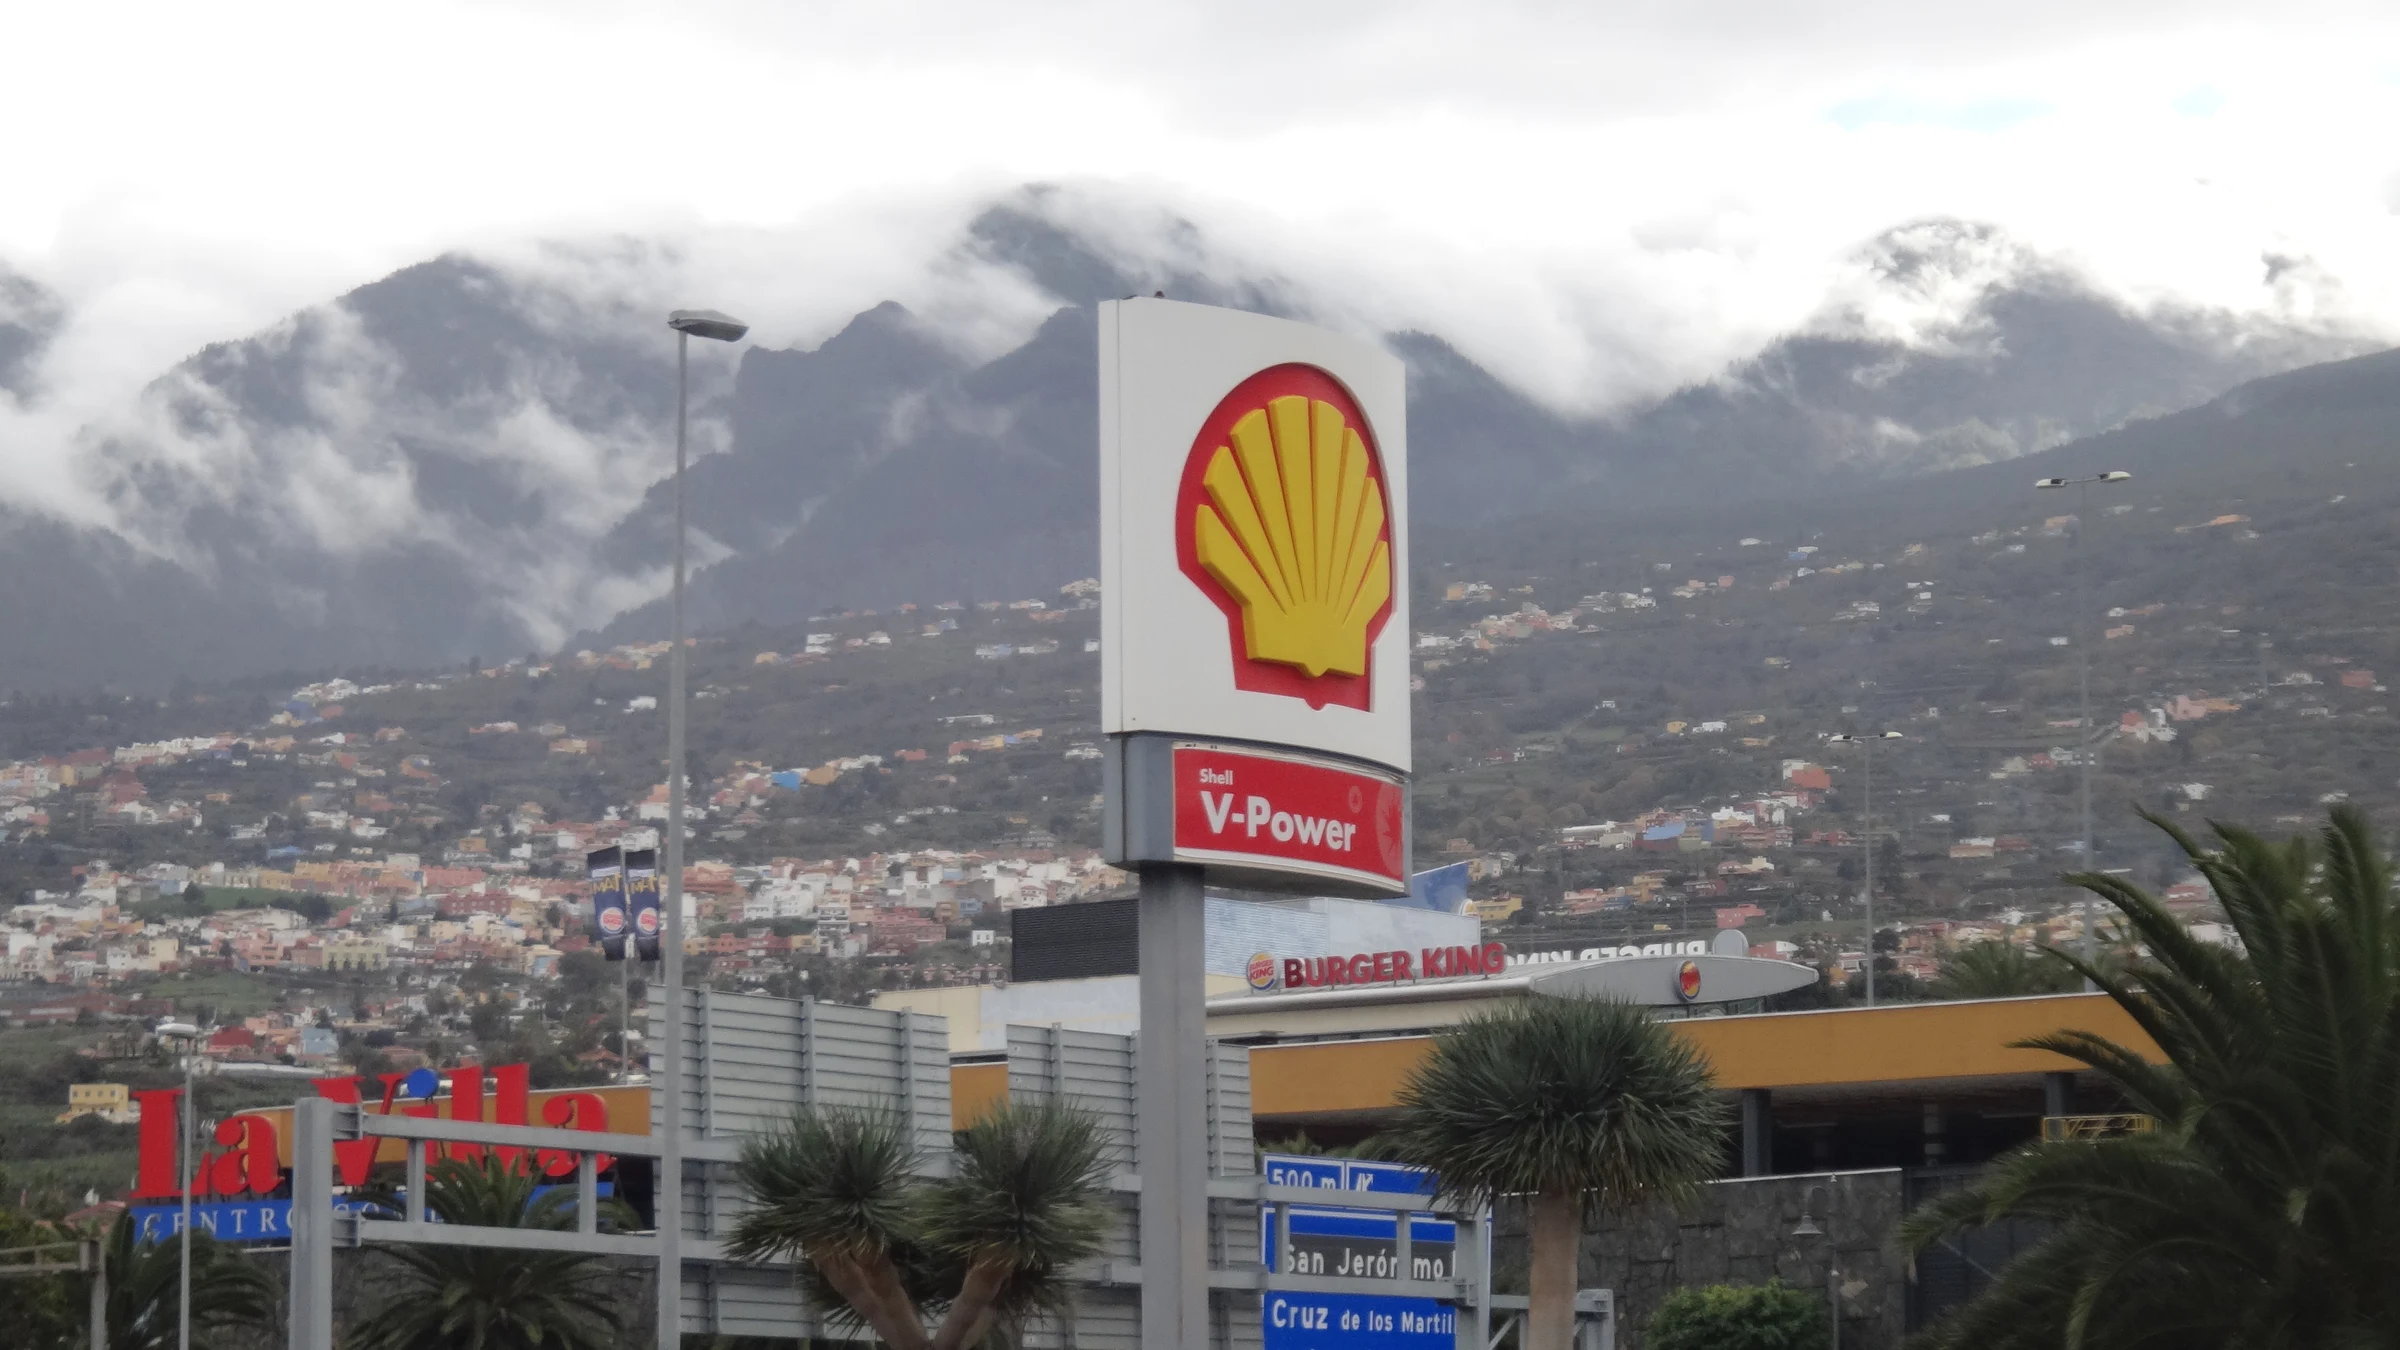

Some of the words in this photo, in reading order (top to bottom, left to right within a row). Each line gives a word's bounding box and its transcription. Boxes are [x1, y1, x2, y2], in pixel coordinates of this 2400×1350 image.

[1200, 768, 1233, 786] Shell
[1201, 791, 1356, 852] V-Power
[1249, 966, 1274, 981] KING
[1284, 950, 1414, 988] BURGER
[1422, 942, 1507, 979] KING
[130, 1089, 286, 1198] La
[310, 1063, 617, 1188] Villa
[1272, 1168, 1313, 1188] 500
[1321, 1177, 1336, 1190] m
[143, 1207, 293, 1241] CENTR
[1337, 1248, 1444, 1279] Jerónmo
[1273, 1299, 1328, 1330] Cruz
[1341, 1310, 1360, 1331] de
[1369, 1311, 1393, 1332] los
[1402, 1312, 1457, 1334] Martil
